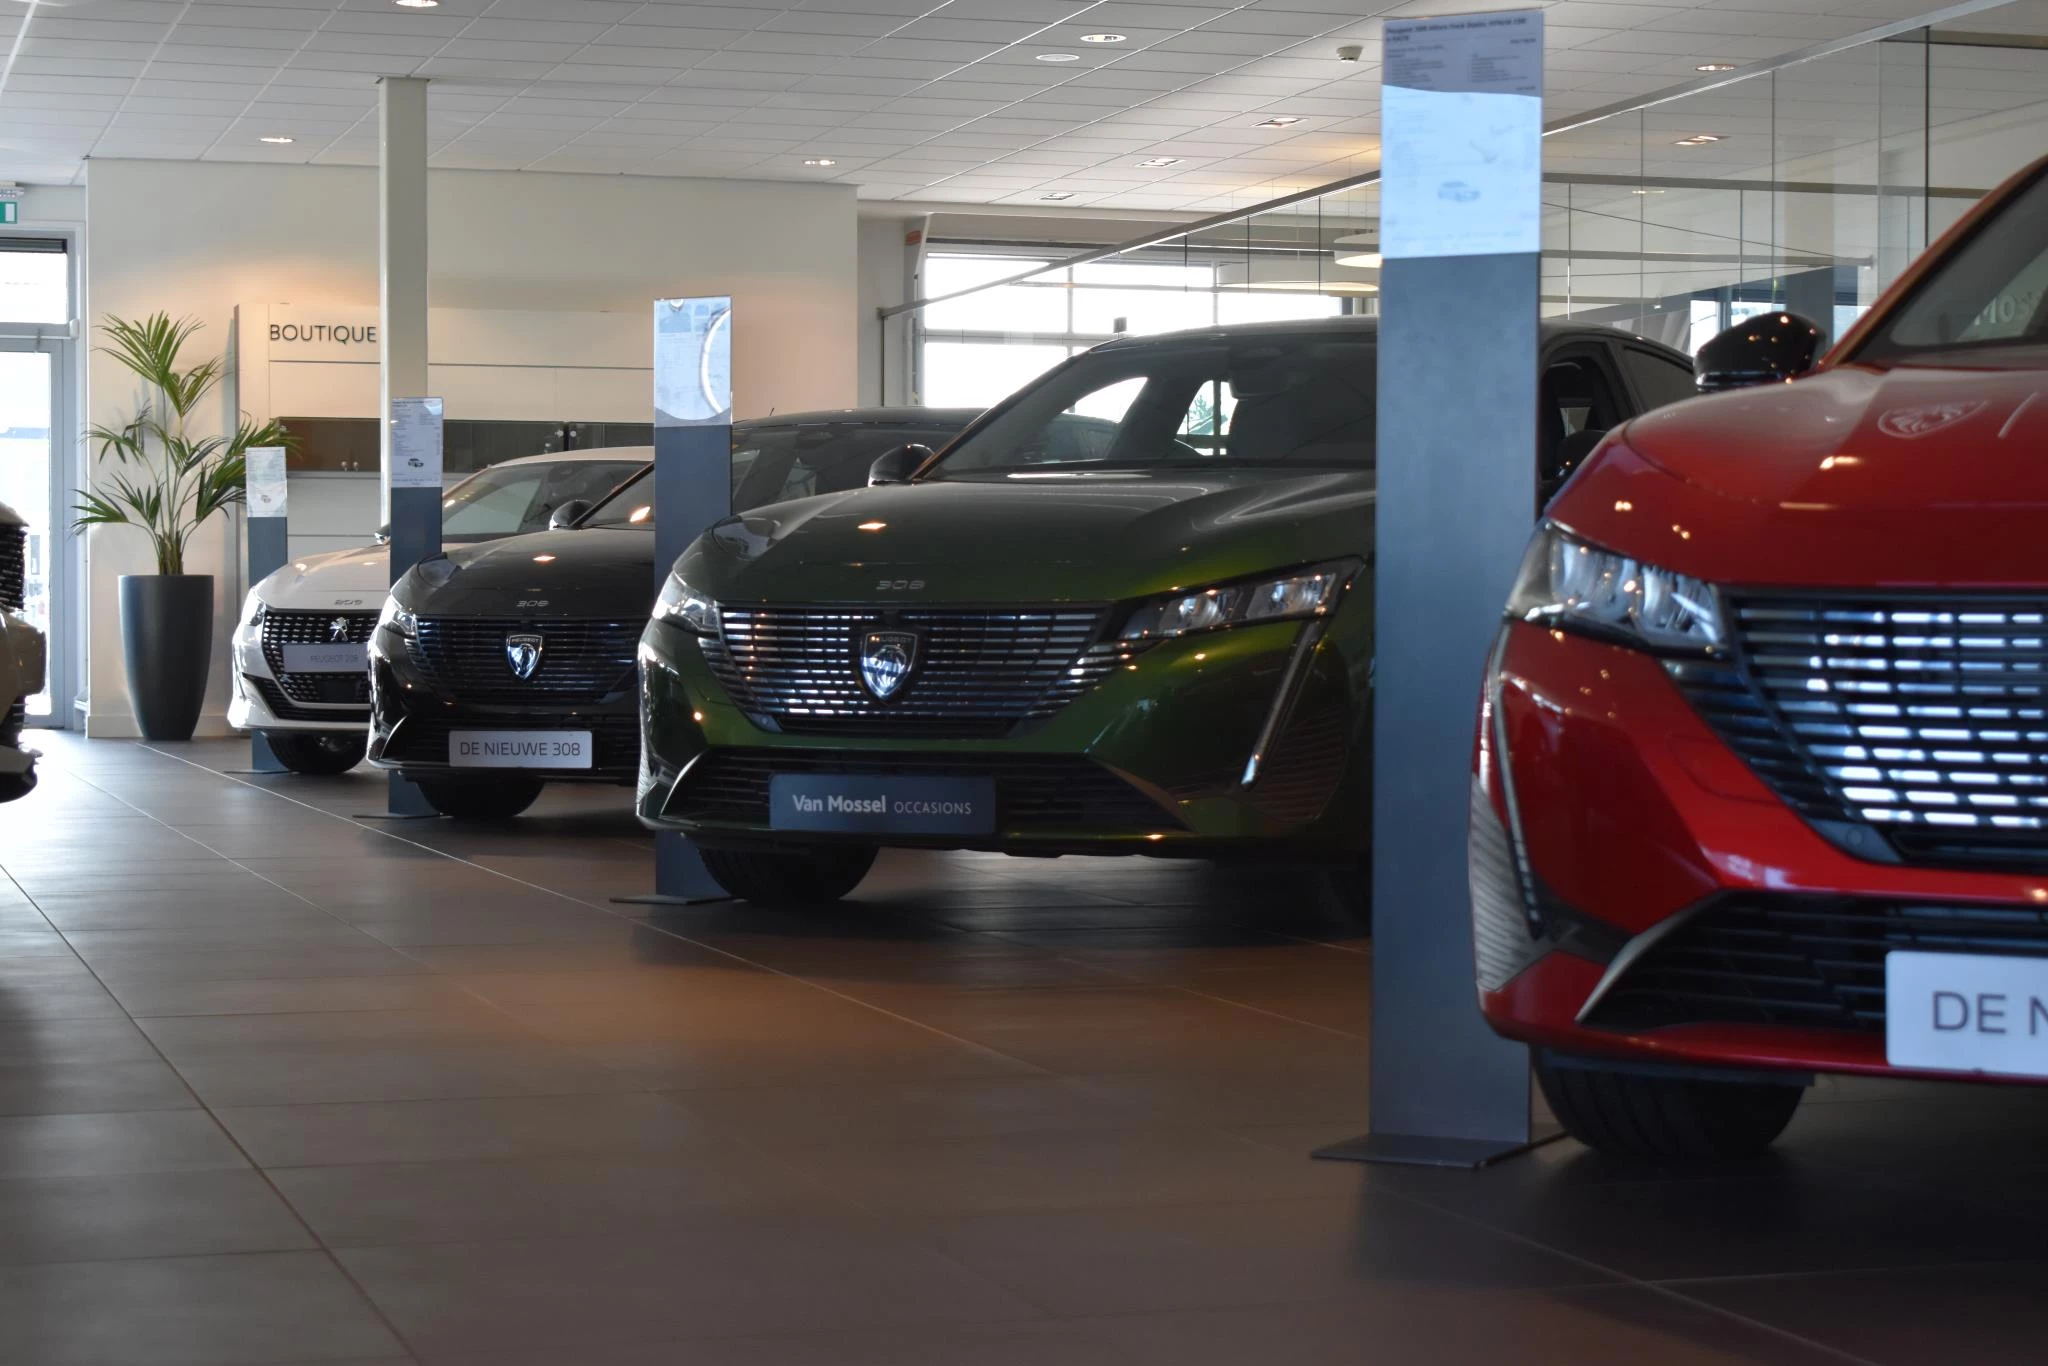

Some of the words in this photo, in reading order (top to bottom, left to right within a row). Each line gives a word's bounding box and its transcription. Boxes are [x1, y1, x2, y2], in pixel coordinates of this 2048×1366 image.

[270, 324, 376, 345] BOUTIQUE
[875, 579, 926, 590] 308
[460, 742, 480, 756] DE
[484, 742, 548, 756] NIEUWE
[552, 742, 580, 756] 308
[792, 794, 823, 812] Van
[828, 795, 887, 813] Mossel
[894, 801, 971, 815] OCCASIONS
[1932, 990, 2007, 1034] DE
